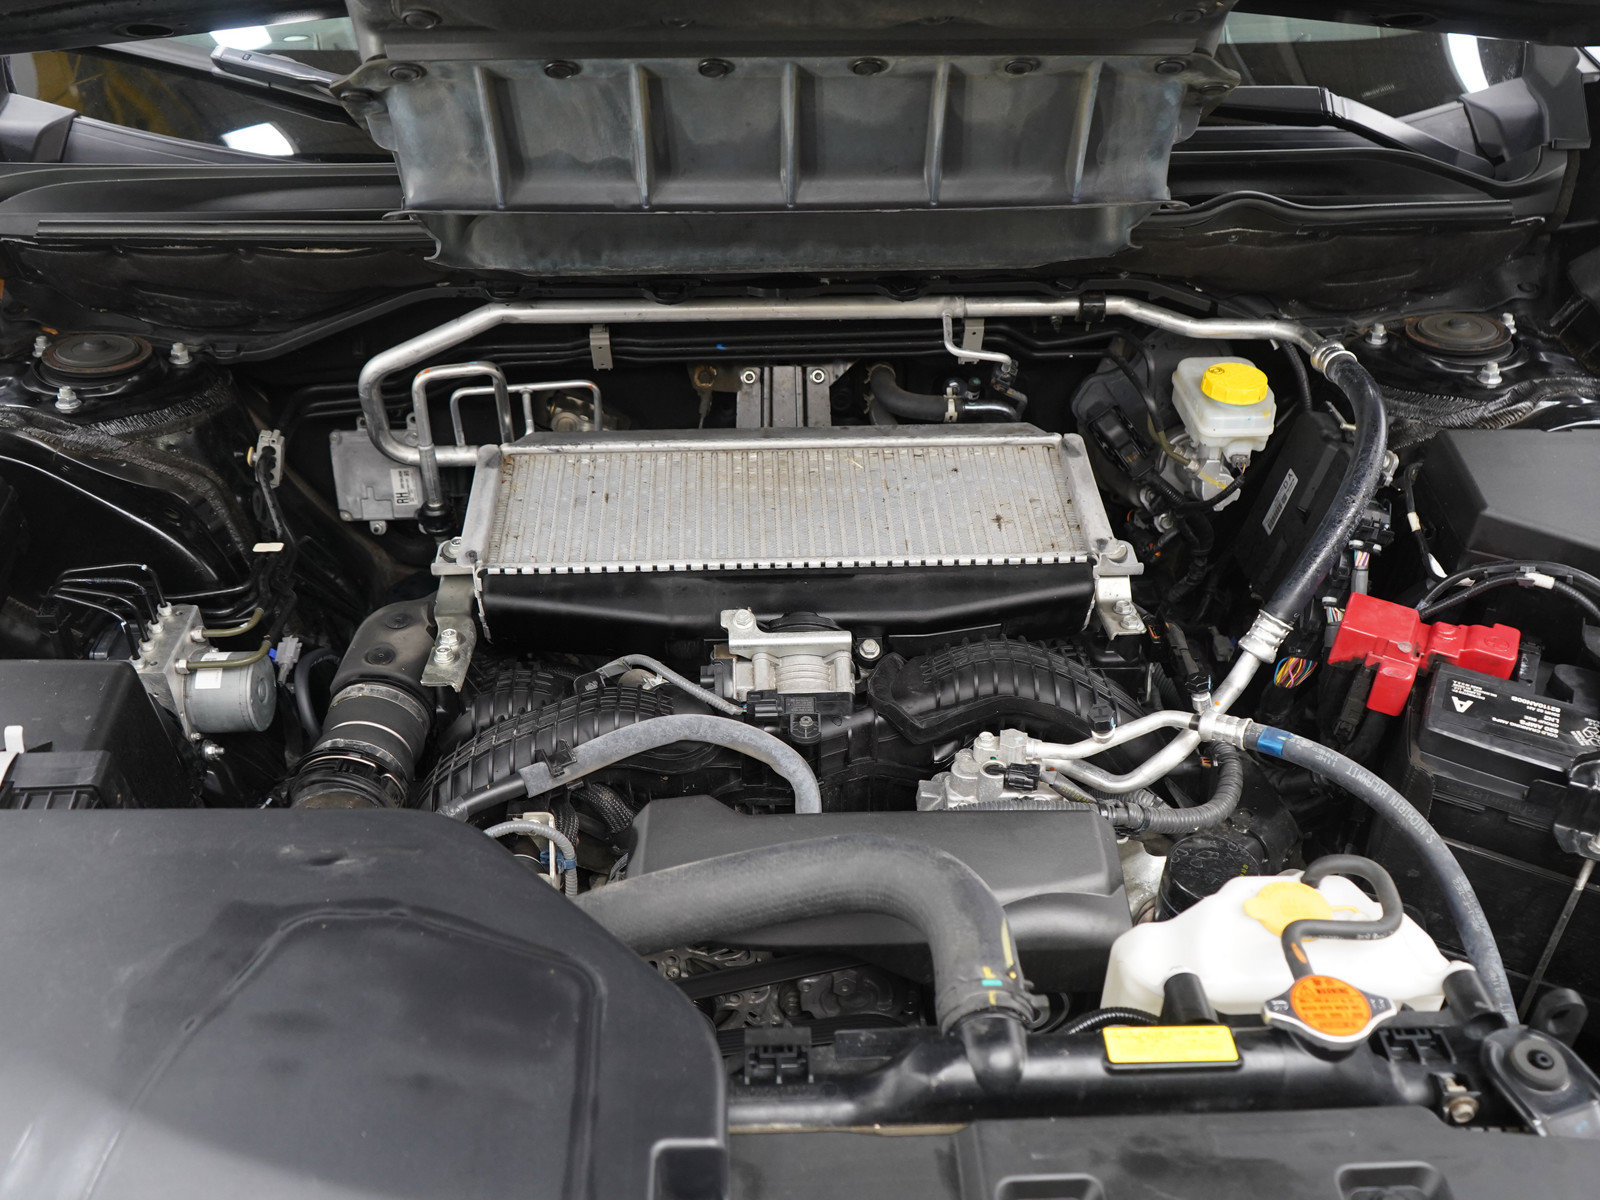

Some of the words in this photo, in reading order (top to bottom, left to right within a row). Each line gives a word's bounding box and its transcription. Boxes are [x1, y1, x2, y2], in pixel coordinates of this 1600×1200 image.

[1492, 716, 1509, 725] AMPS
[1519, 719, 1544, 729] AMPS
[1537, 719, 1559, 728] GROUP
[1509, 721, 1541, 733] CRANKING
[1541, 730, 1558, 738] COLD
